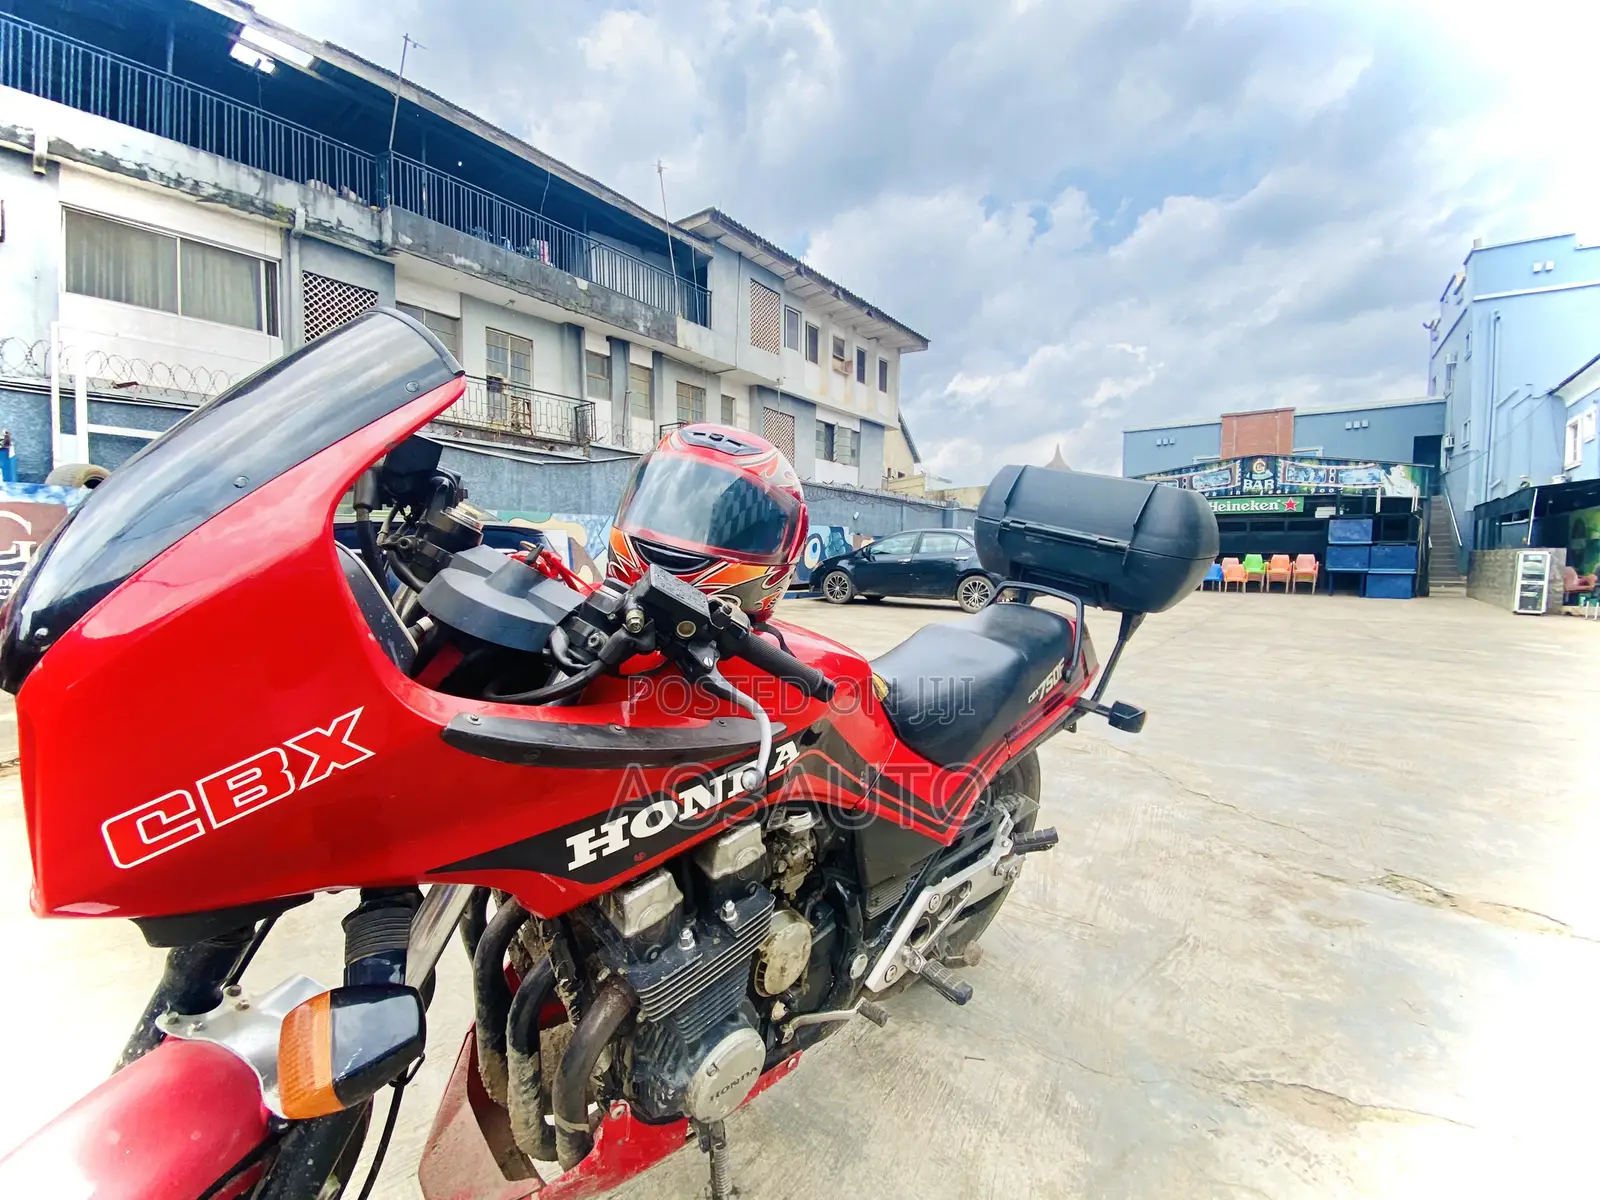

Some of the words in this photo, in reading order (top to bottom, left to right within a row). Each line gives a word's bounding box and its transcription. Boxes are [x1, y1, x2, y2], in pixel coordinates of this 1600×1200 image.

[1243, 479, 1275, 490] BAR
[1209, 500, 1280, 512] Heineken
[101, 706, 376, 869] CBX
